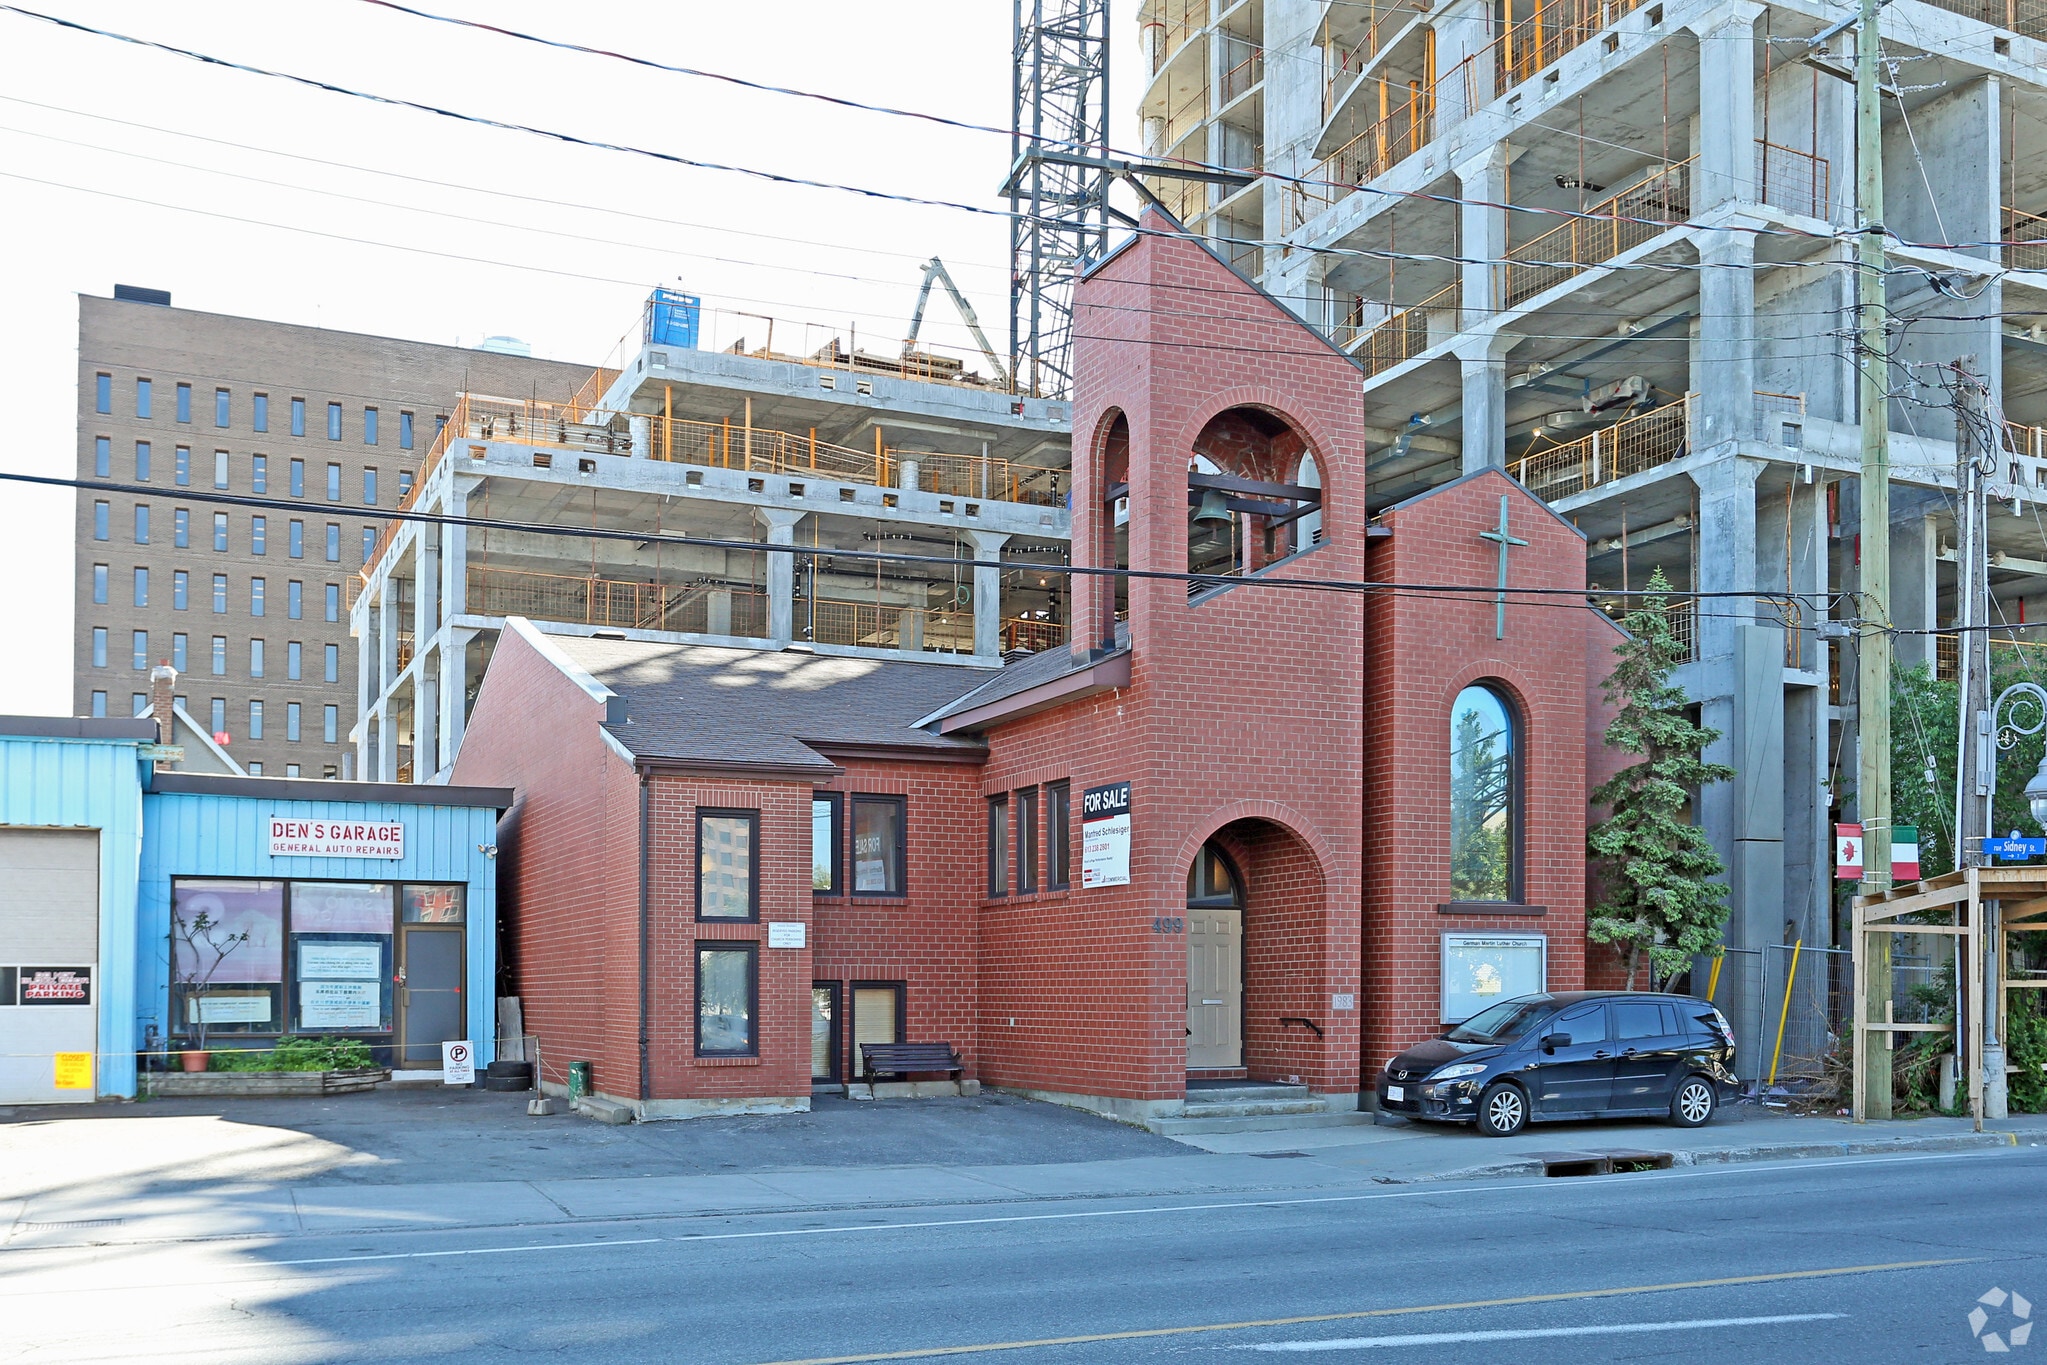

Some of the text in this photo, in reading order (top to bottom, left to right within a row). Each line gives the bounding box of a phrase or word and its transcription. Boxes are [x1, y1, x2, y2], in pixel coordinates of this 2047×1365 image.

[1084, 787, 1127, 813] FOR SALE
[273, 822, 401, 842] DEN'S GARAGE
[273, 843, 399, 855] GENERAL AUTO REPAIRS
[2003, 840, 2027, 855] Sidney
[1152, 916, 1184, 933] 499
[1334, 995, 1353, 1008] 1983
